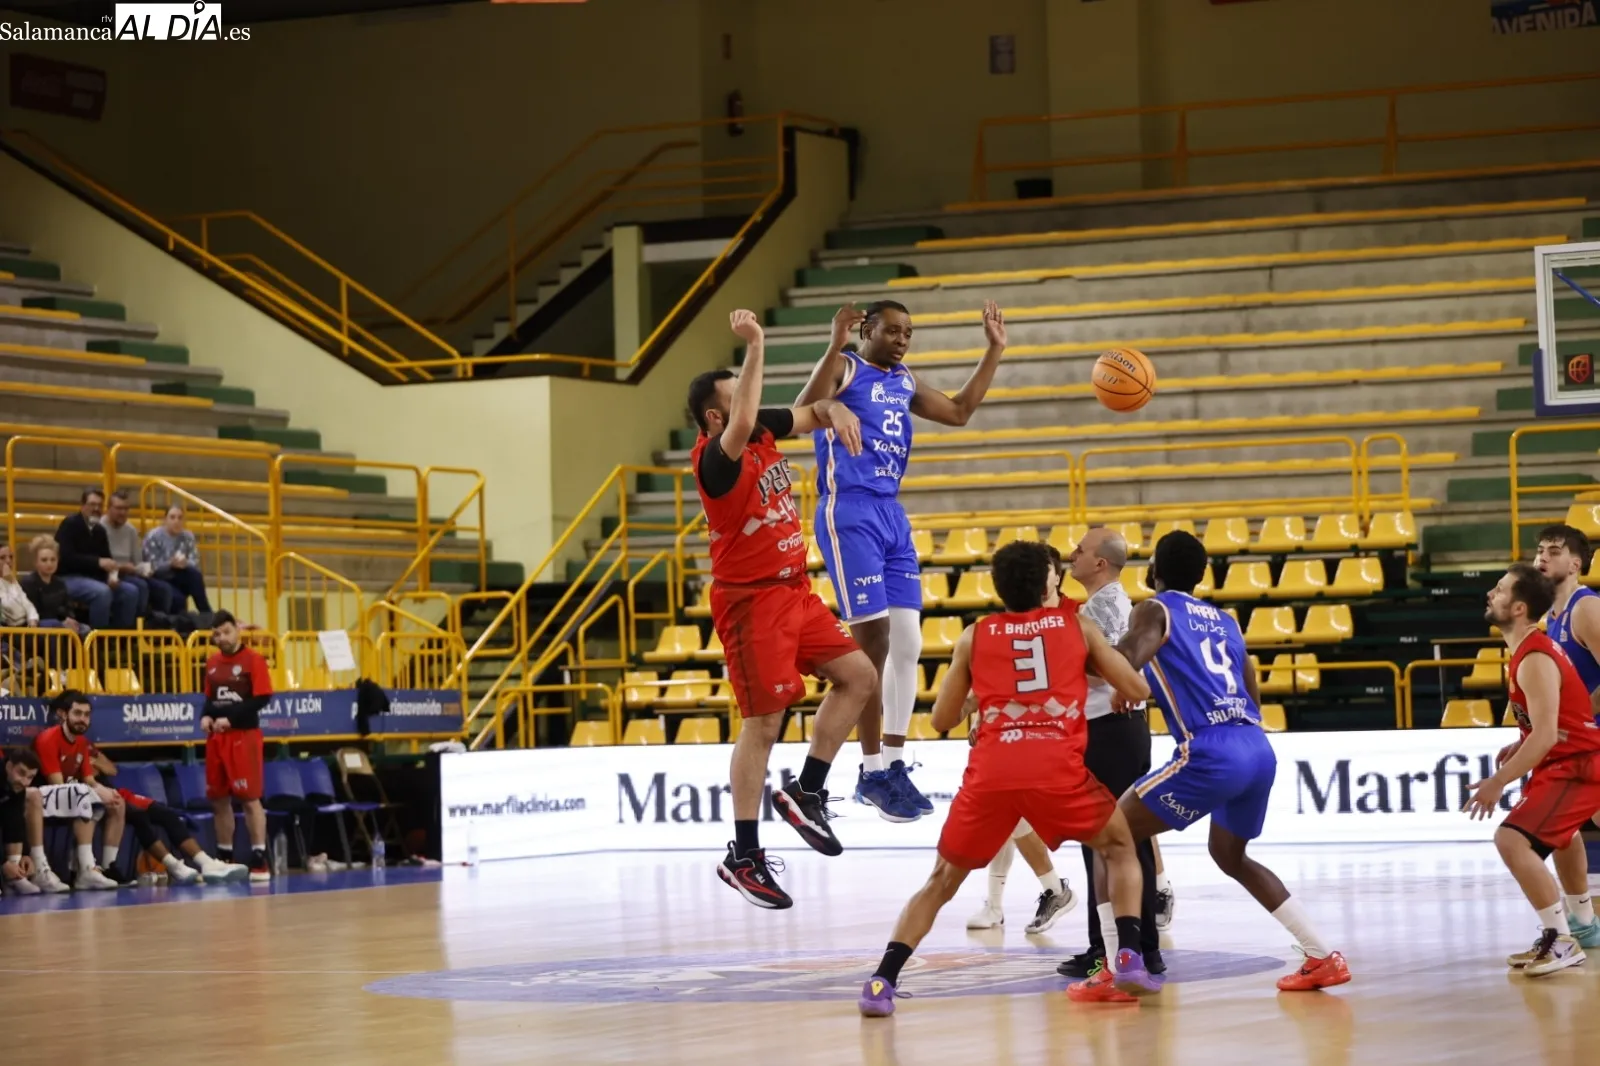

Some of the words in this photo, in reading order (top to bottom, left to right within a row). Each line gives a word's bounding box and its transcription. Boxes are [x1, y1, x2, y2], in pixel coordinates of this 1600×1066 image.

[1491, 0, 1598, 34] AVENIDA
[882, 409, 904, 437] 25
[989, 624, 1002, 636] T.
[1012, 635, 1049, 693] 3
[1200, 636, 1237, 694] 4
[40, 704, 50, 724] Y
[123, 702, 194, 722] SALAMANCA
[284, 697, 293, 718] Y
[296, 694, 322, 714] LEÓN
[448, 793, 586, 818] www.marfilaclinica.com
